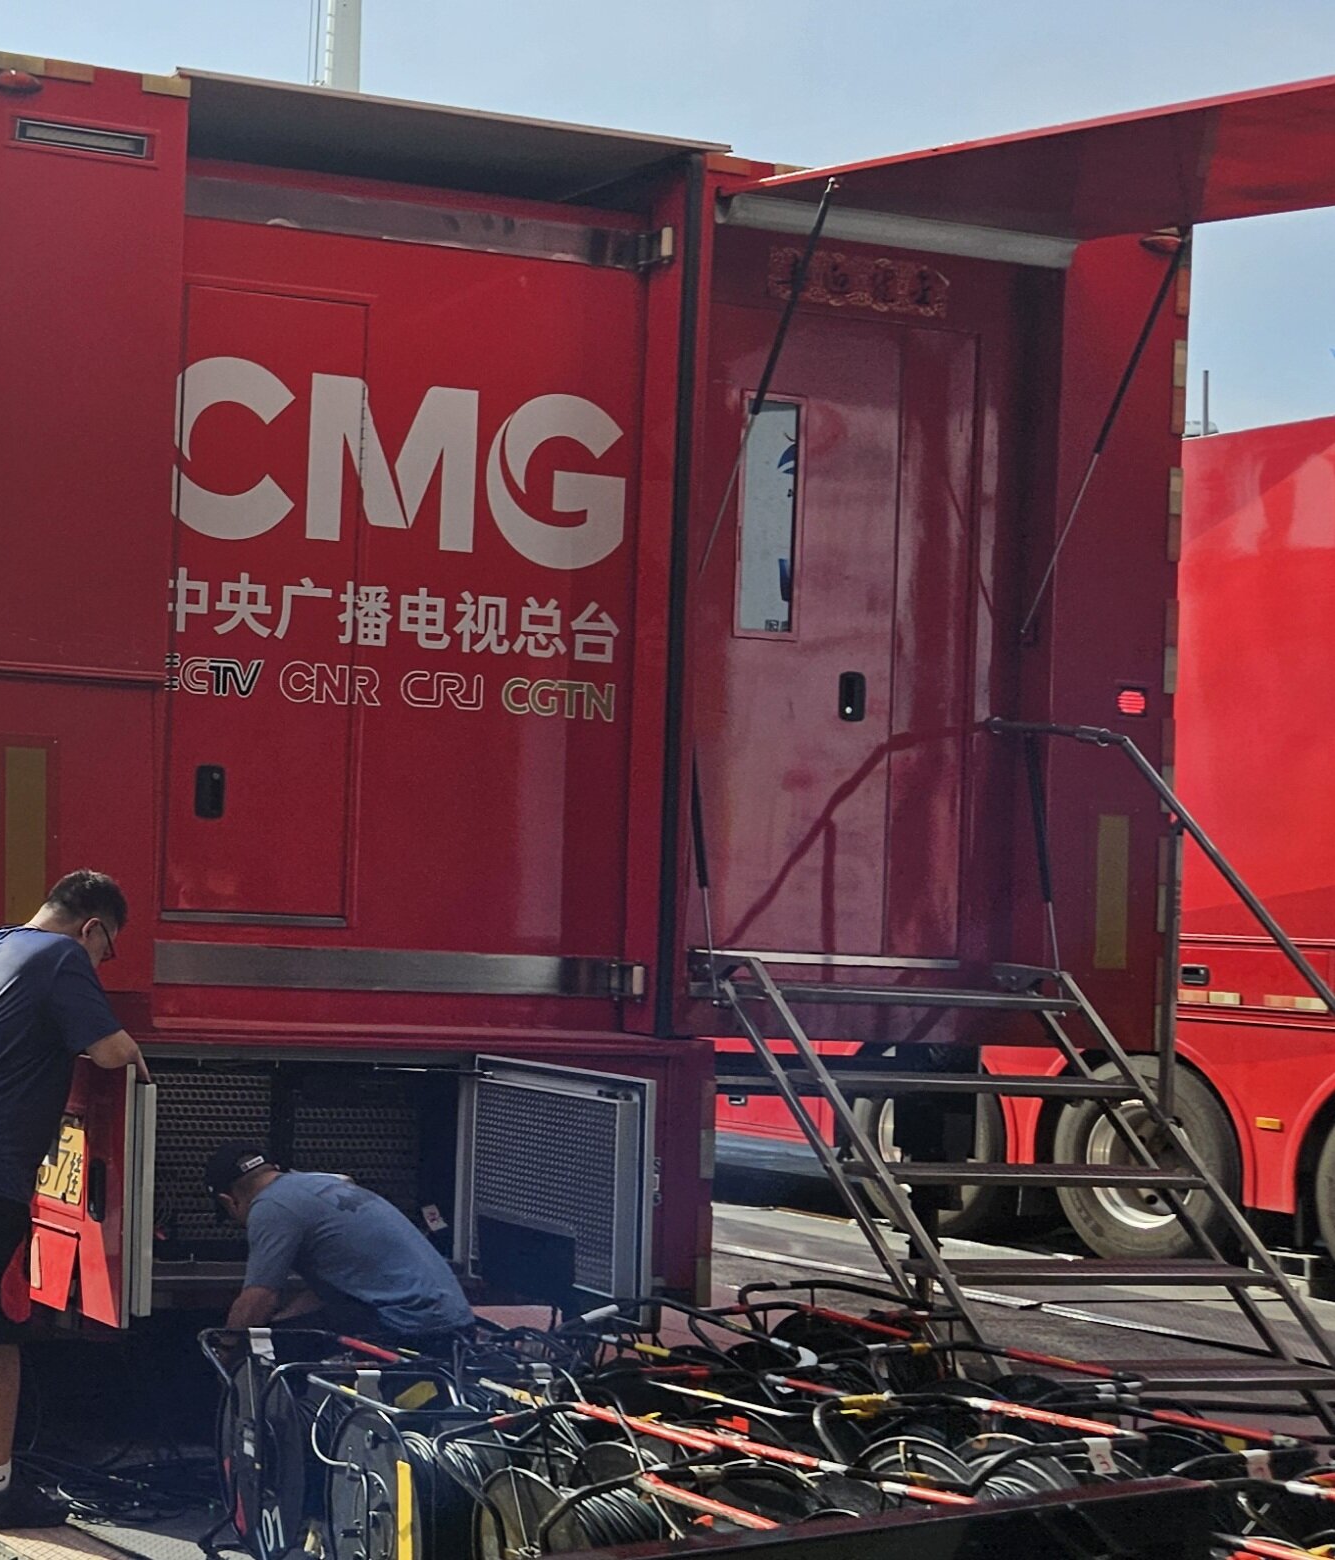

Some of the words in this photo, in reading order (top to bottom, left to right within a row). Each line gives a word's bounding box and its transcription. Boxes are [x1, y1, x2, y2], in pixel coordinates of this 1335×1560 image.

[171, 356, 626, 570] CMG
[168, 567, 621, 664] 中央广播电视总台
[280, 661, 381, 706] CNR
[400, 670, 484, 711] CRI
[502, 677, 616, 722] CGTN
[262, 1505, 285, 1552] 01
